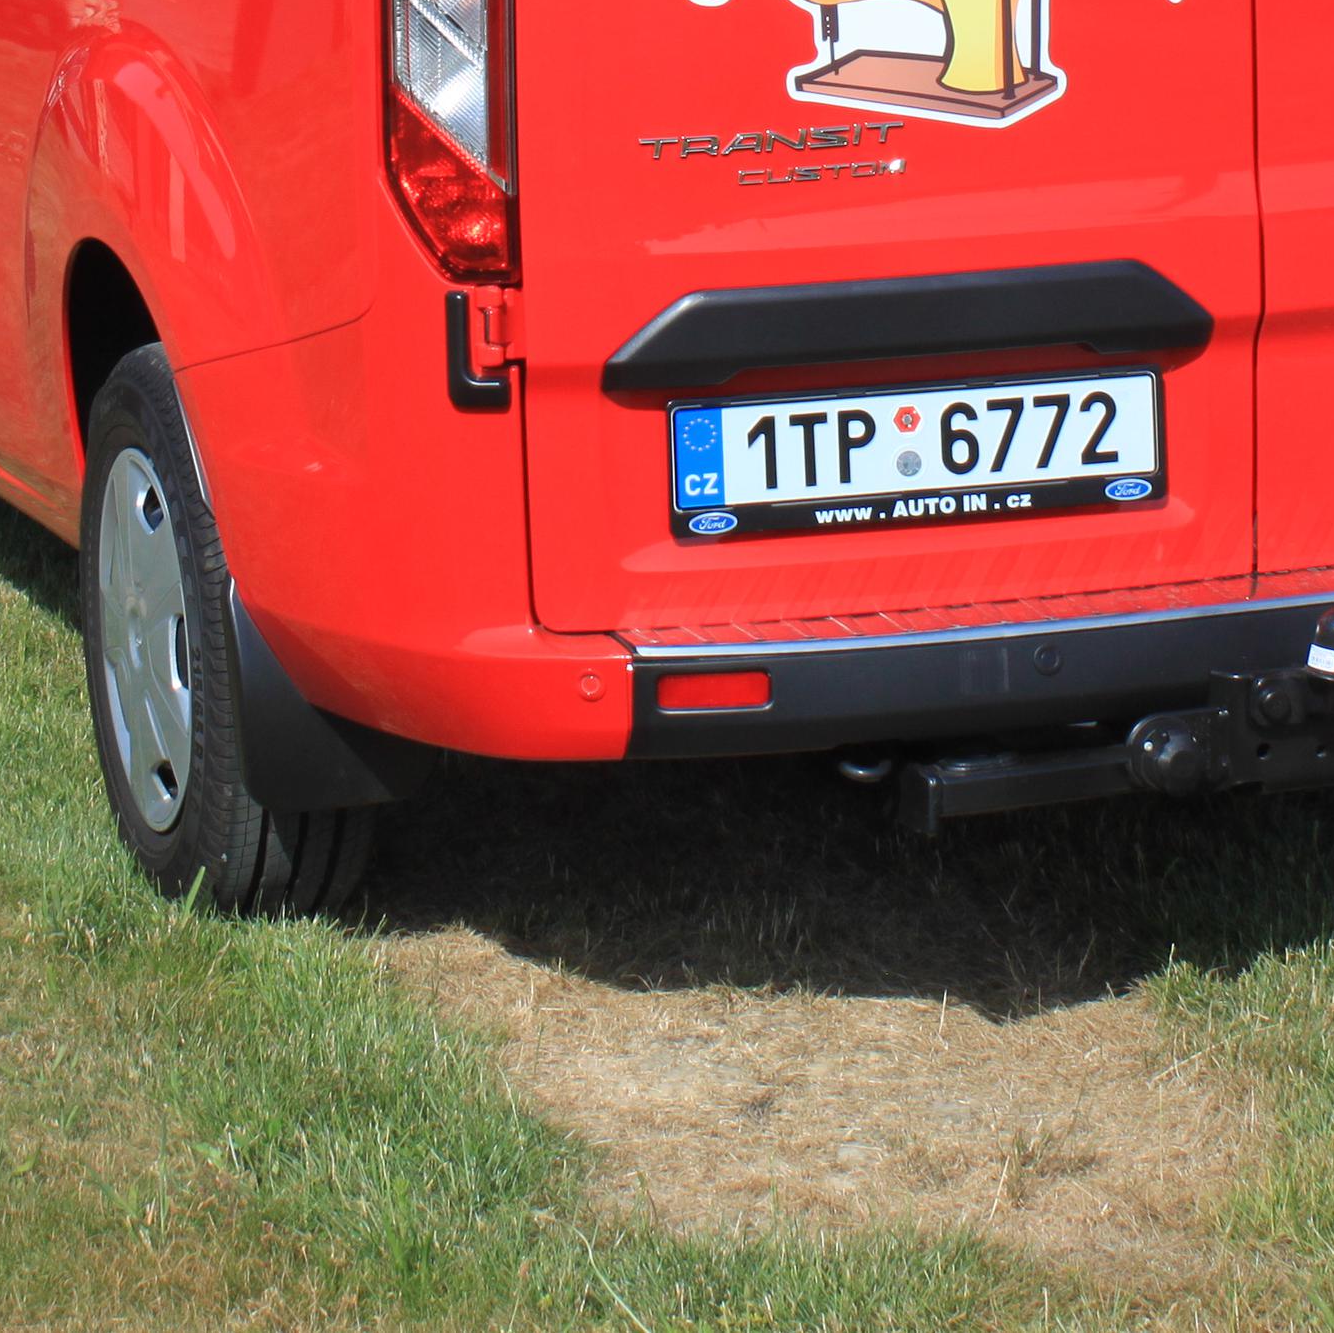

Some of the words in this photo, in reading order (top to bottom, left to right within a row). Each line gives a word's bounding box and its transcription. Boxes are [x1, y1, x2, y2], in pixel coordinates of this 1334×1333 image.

[639, 121, 904, 159] TRANSIT
[738, 159, 906, 185] CUSTOM
[747, 408, 877, 490] 1TP
[939, 390, 1119, 475] 6772
[684, 472, 719, 497] CZ
[893, 496, 951, 518] AUTO
[963, 494, 988, 512] IN
[1007, 493, 1032, 508] cz
